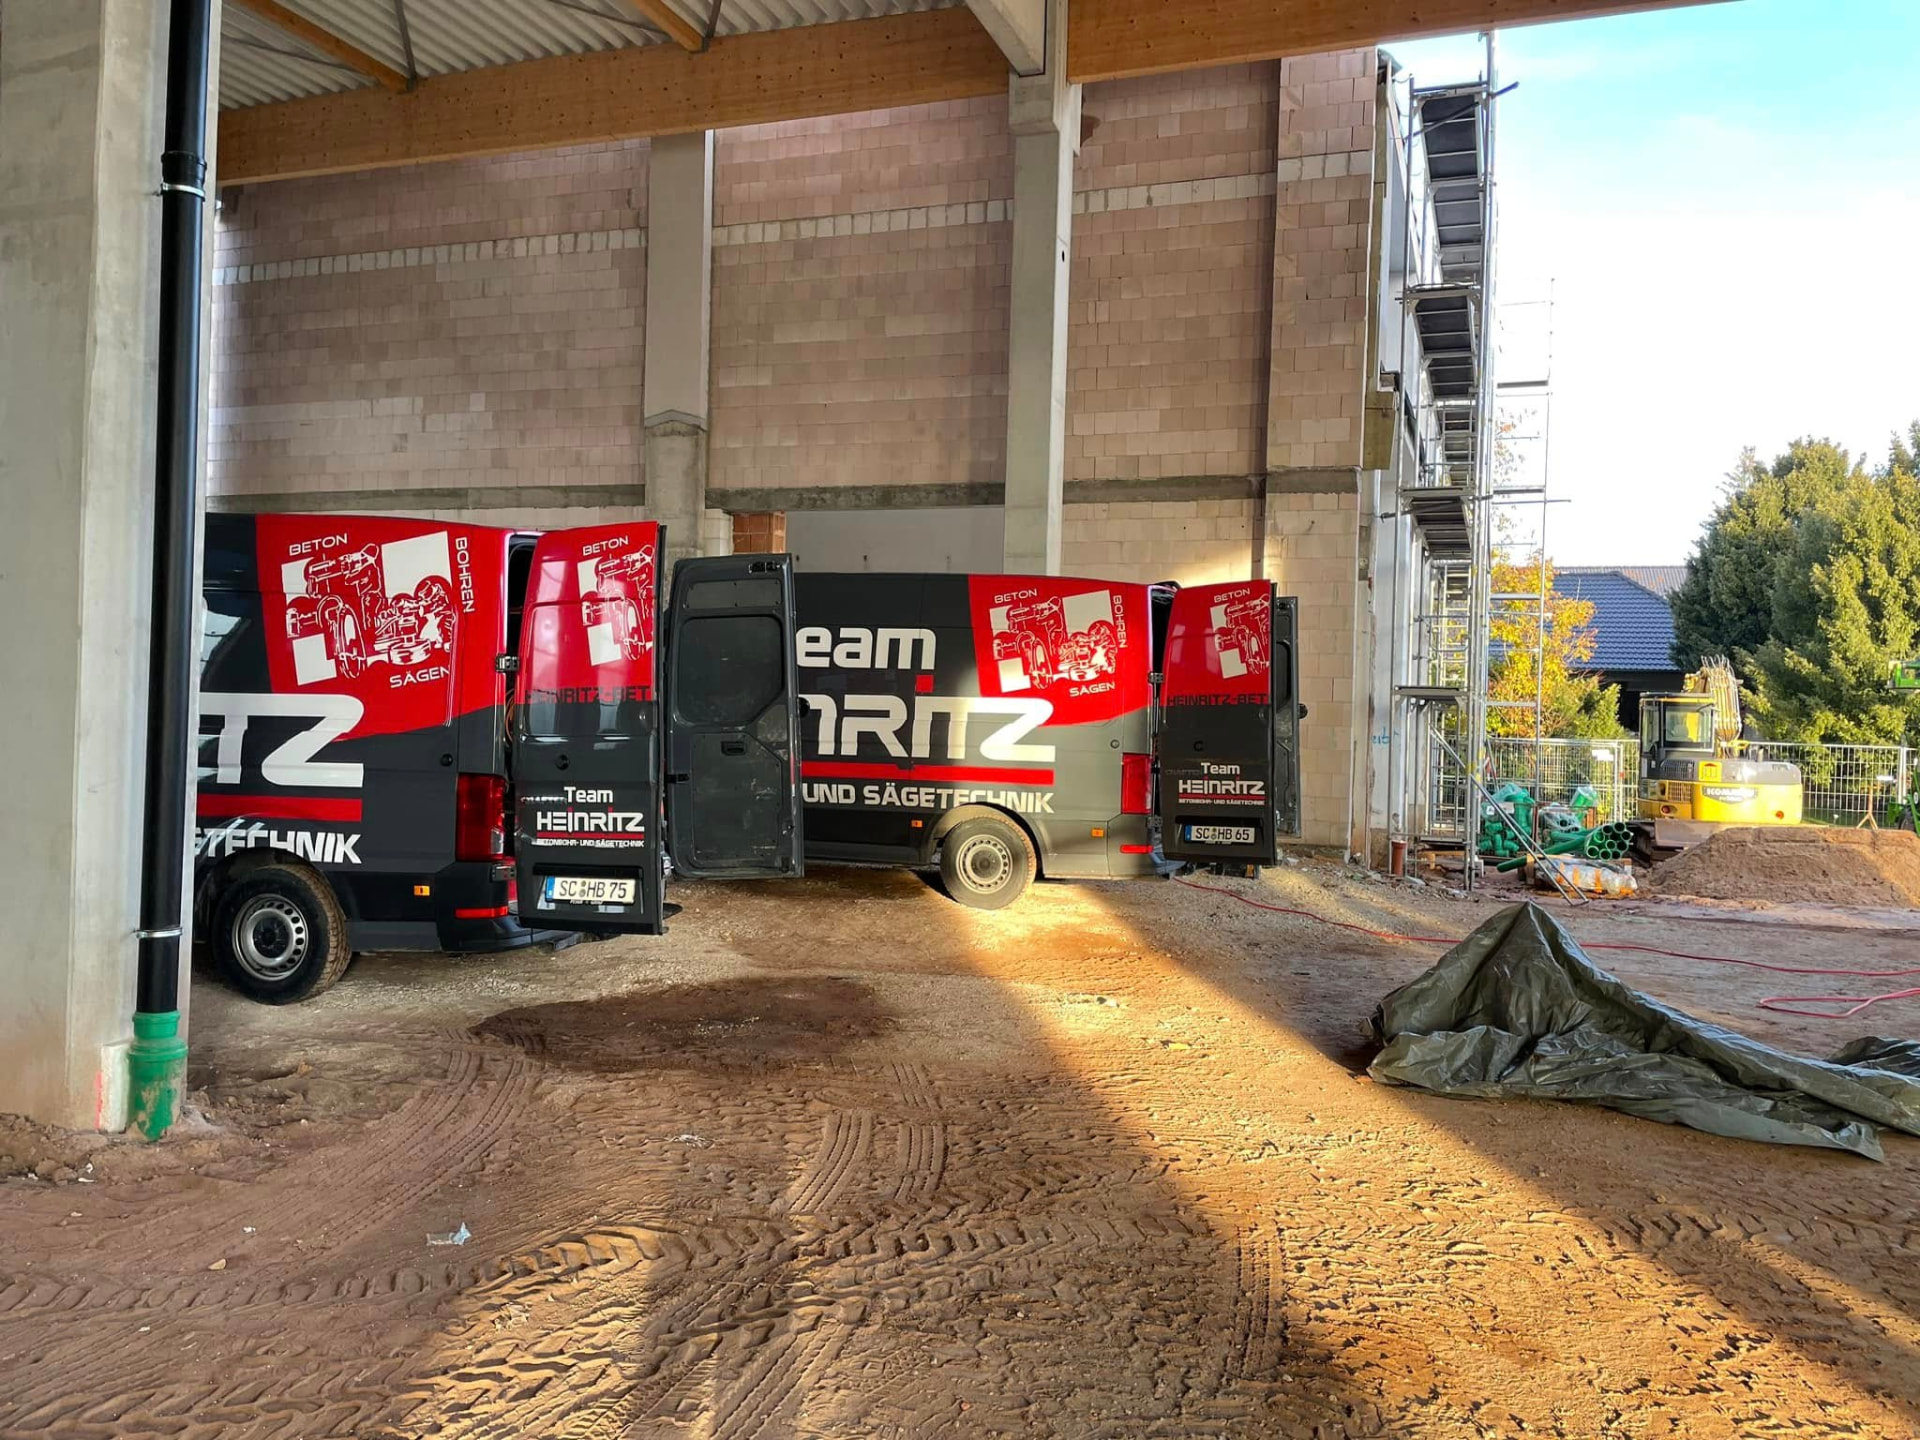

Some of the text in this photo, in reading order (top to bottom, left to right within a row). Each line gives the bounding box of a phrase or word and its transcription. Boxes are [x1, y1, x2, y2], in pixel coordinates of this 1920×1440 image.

[289, 533, 348, 556] BETON
[582, 535, 629, 556] BETON
[455, 537, 475, 613] BOHREN
[994, 588, 1038, 604] BETON
[1213, 587, 1250, 603] BETON
[1112, 595, 1128, 648] BOHREN
[1201, 762, 1241, 775] Team
[563, 786, 614, 803] Team
[802, 783, 856, 804] UND
[1195, 828, 1250, 841] SC HB 65
[559, 880, 627, 899] SC HB 75
